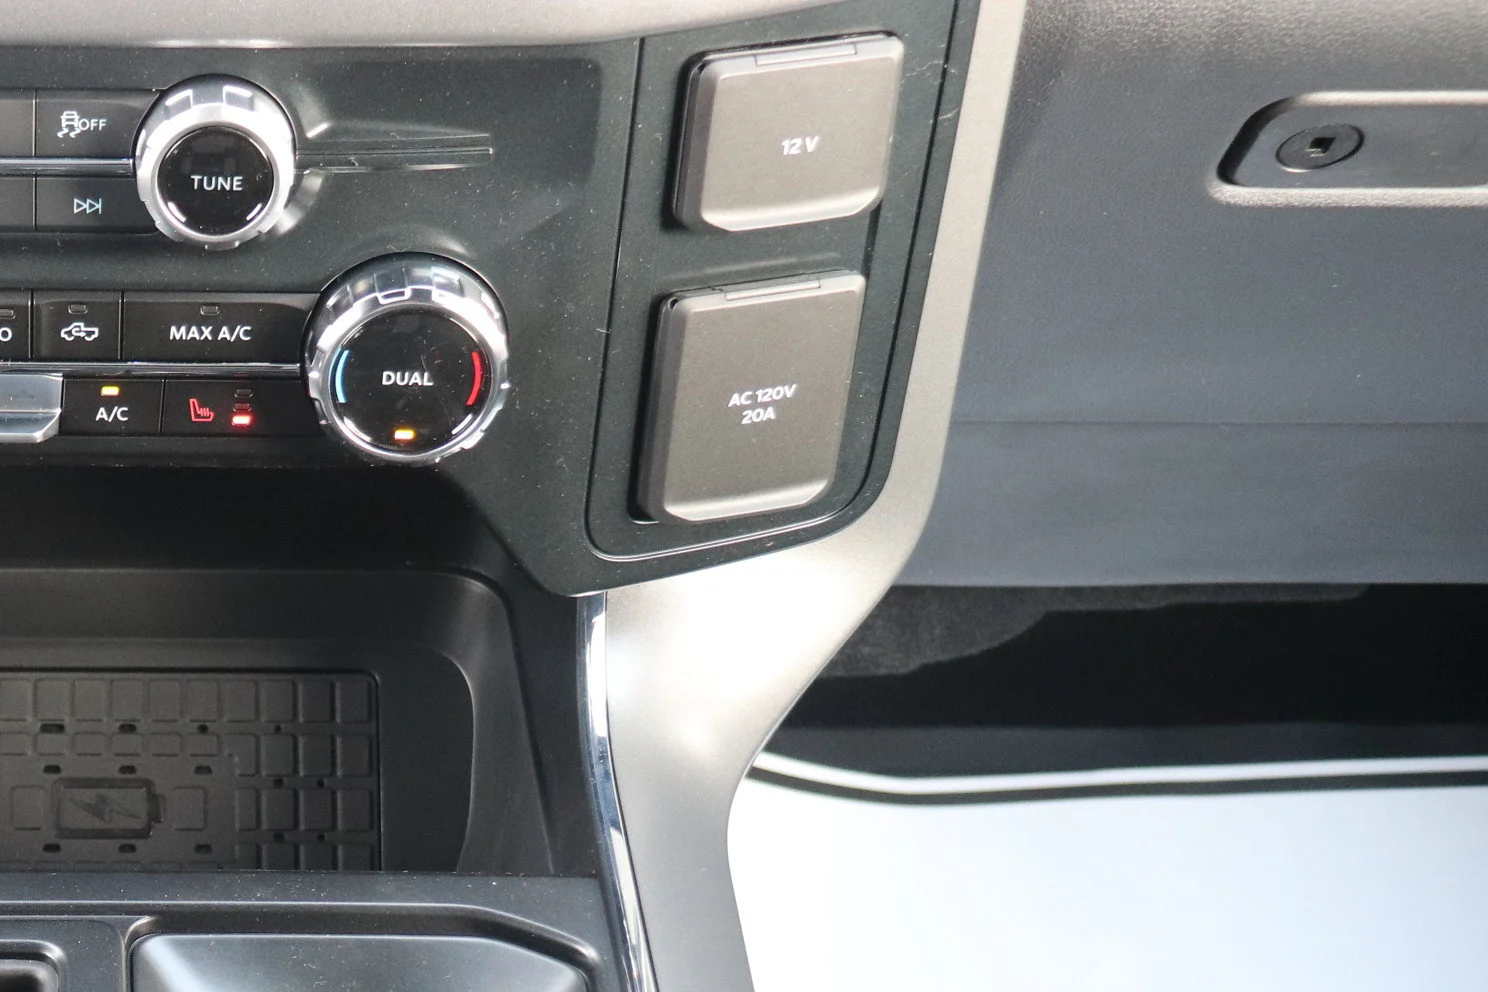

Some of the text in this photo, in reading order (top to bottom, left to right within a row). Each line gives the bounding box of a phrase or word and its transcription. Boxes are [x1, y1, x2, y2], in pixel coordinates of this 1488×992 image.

[78, 118, 107, 134] OFF
[781, 136, 820, 156] 12 V
[190, 175, 244, 192] TUNE
[169, 325, 252, 343] MAX A/C
[381, 370, 434, 387] DUAL
[727, 383, 797, 408] AC 120V
[95, 406, 129, 423] A/C
[741, 407, 776, 425] 20A
